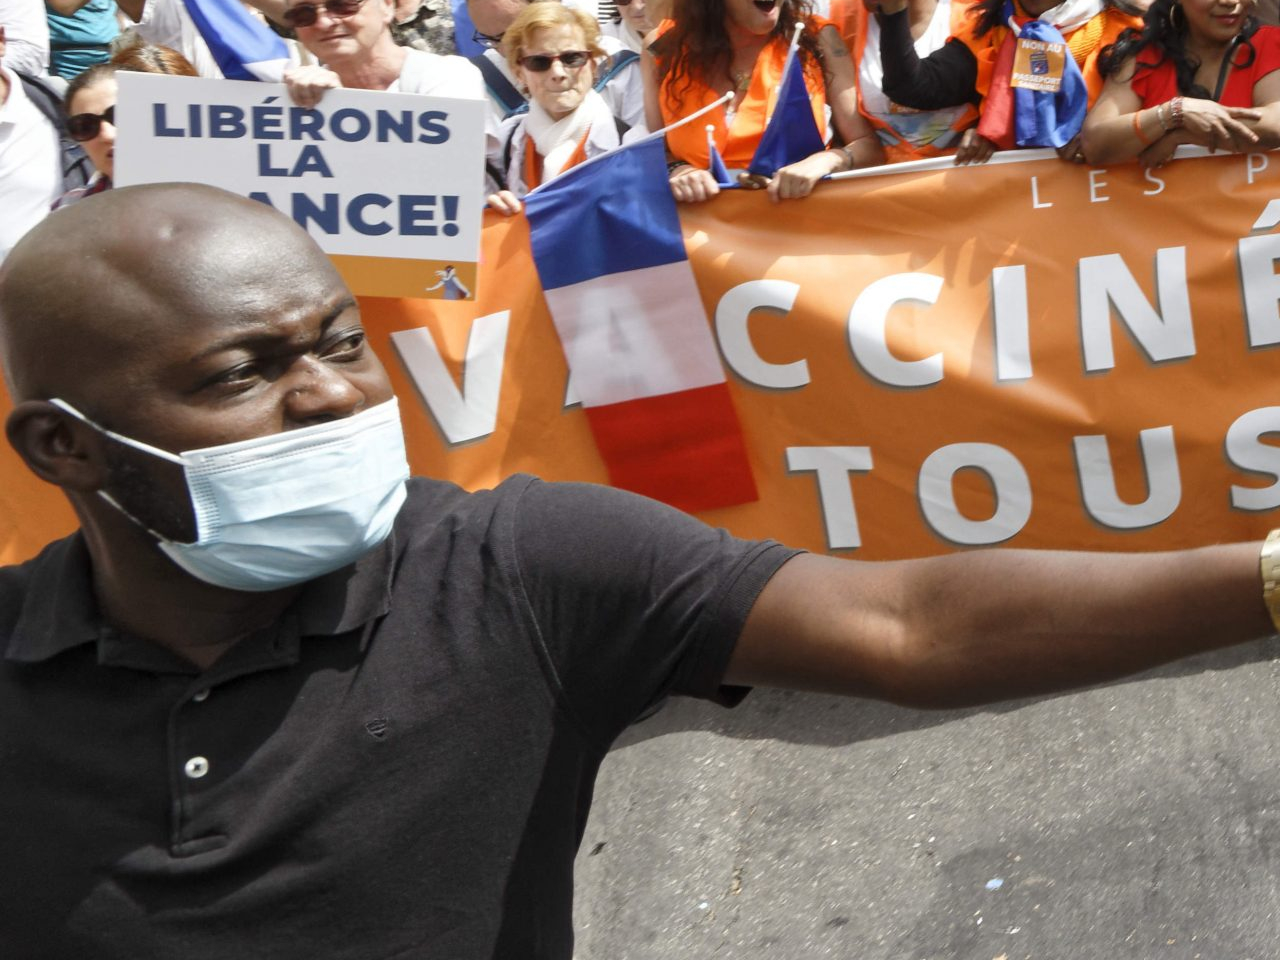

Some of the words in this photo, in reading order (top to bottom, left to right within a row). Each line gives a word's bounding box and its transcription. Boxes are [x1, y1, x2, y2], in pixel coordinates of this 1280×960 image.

[1021, 40, 1044, 51] NON
[1046, 43, 1062, 53] AU
[152, 95, 451, 146] LIBÉRONS
[257, 142, 333, 178] LA
[1030, 167, 1166, 210] LES
[250, 191, 460, 238] ANCE!
